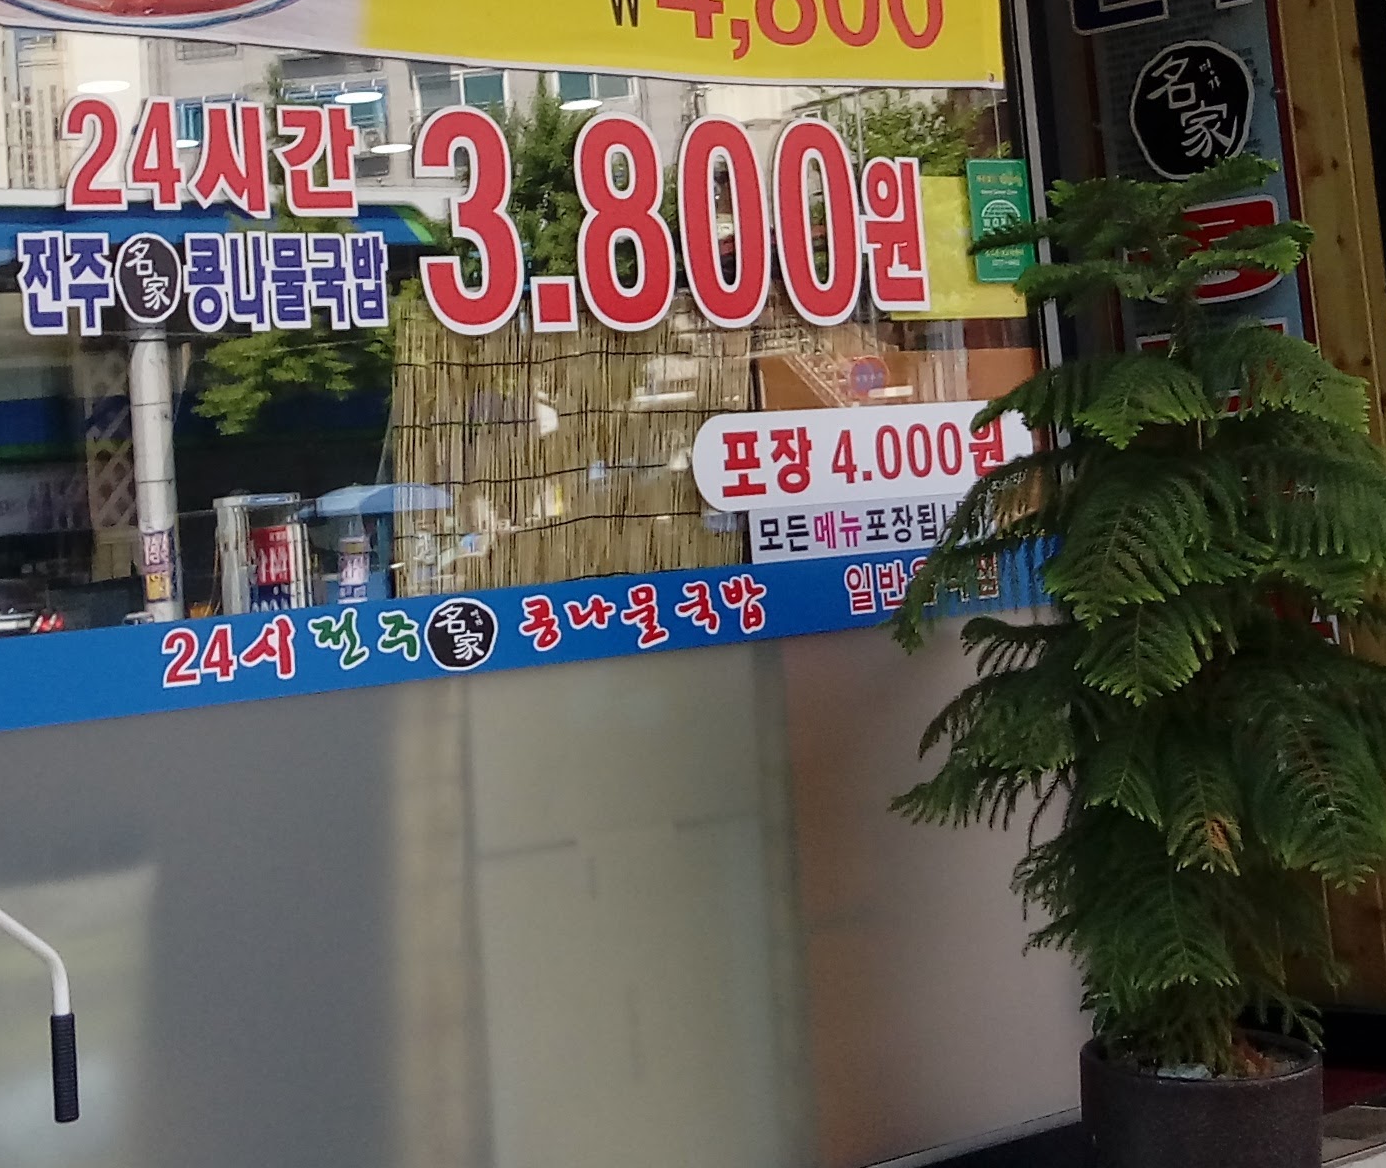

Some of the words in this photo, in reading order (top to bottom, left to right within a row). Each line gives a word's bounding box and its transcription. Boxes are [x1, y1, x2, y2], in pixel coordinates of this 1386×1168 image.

[66, 99, 356, 214] 24시간
[1147, 55, 1239, 159] 名家
[420, 108, 927, 328] 3.800원
[20, 235, 111, 329] 전주
[187, 235, 385, 327] 콩나물국밥
[722, 425, 813, 499] 포장
[832, 414, 1006, 484] 4.000원
[164, 617, 294, 686] 24시
[310, 608, 420, 667] 전주
[521, 576, 765, 649] 콩나물국밥
